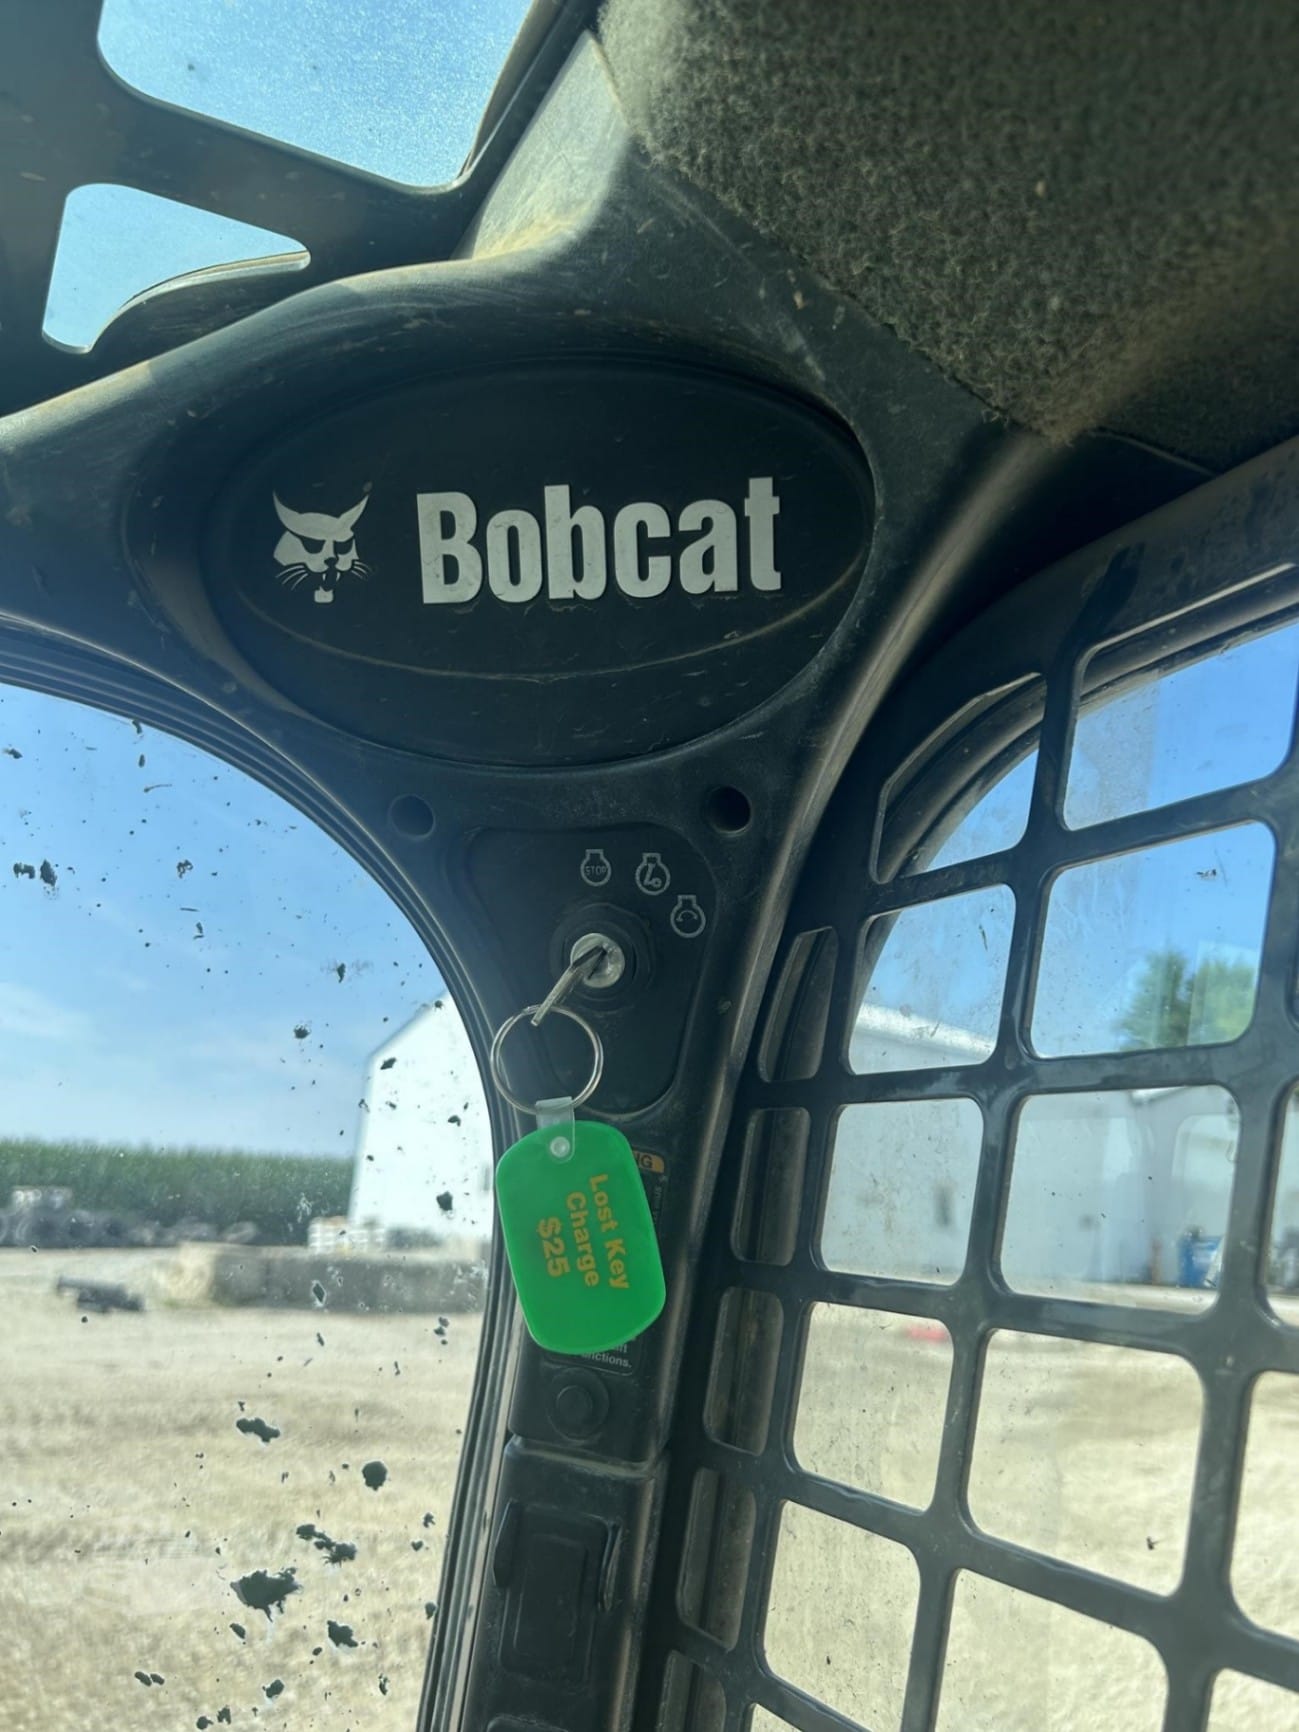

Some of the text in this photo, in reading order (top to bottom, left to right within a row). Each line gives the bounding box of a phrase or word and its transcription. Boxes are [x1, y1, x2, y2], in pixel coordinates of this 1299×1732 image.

[417, 477, 781, 604] Bobcat
[585, 865, 607, 876] STOP
[537, 1216, 570, 1278] $25
[566, 1191, 599, 1288] Charge
[589, 1174, 629, 1289] Lost Key
